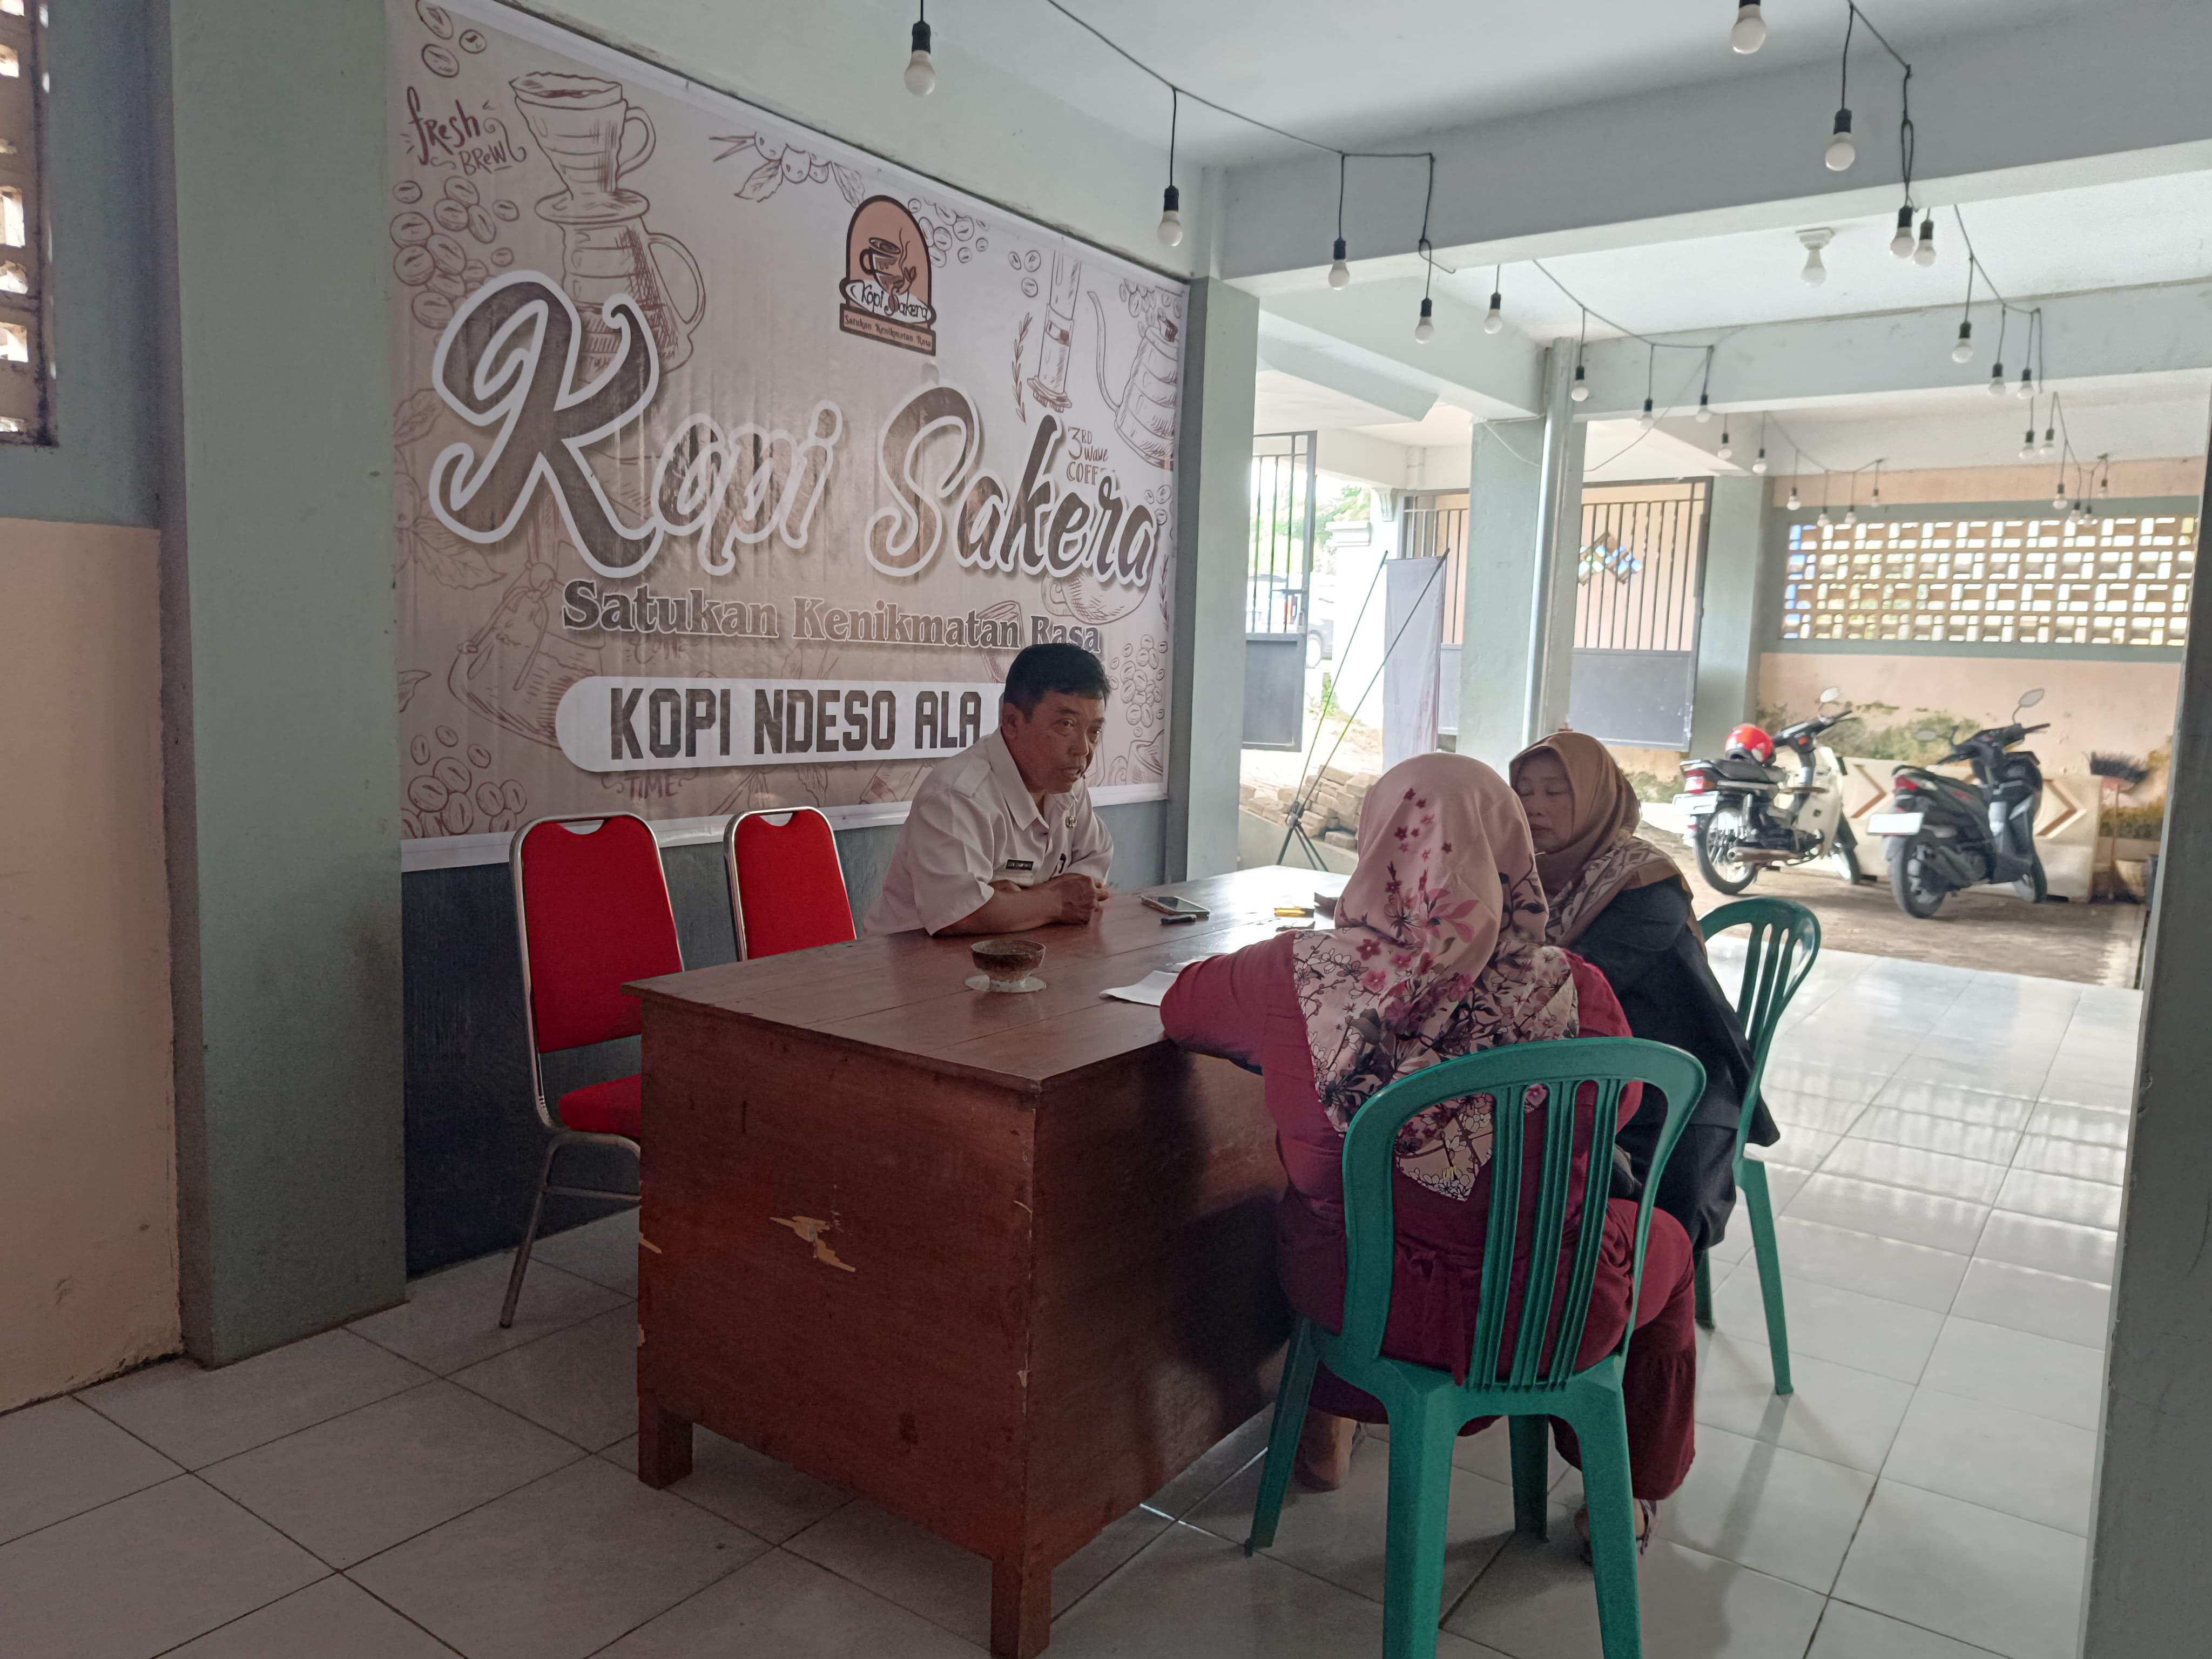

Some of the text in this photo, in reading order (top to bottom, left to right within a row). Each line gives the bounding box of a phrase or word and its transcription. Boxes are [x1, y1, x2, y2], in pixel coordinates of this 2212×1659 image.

[861, 285, 928, 322] Kopi Sakera
[431, 270, 1158, 586] Kopi Sakera
[1067, 461, 1116, 485] COFF
[563, 579, 1101, 653] Satukan Kenikmatan Rasa
[611, 687, 731, 760] KOPI
[754, 689, 896, 754] NDESO
[915, 691, 982, 750] ALA
[624, 773, 679, 801] TIME
